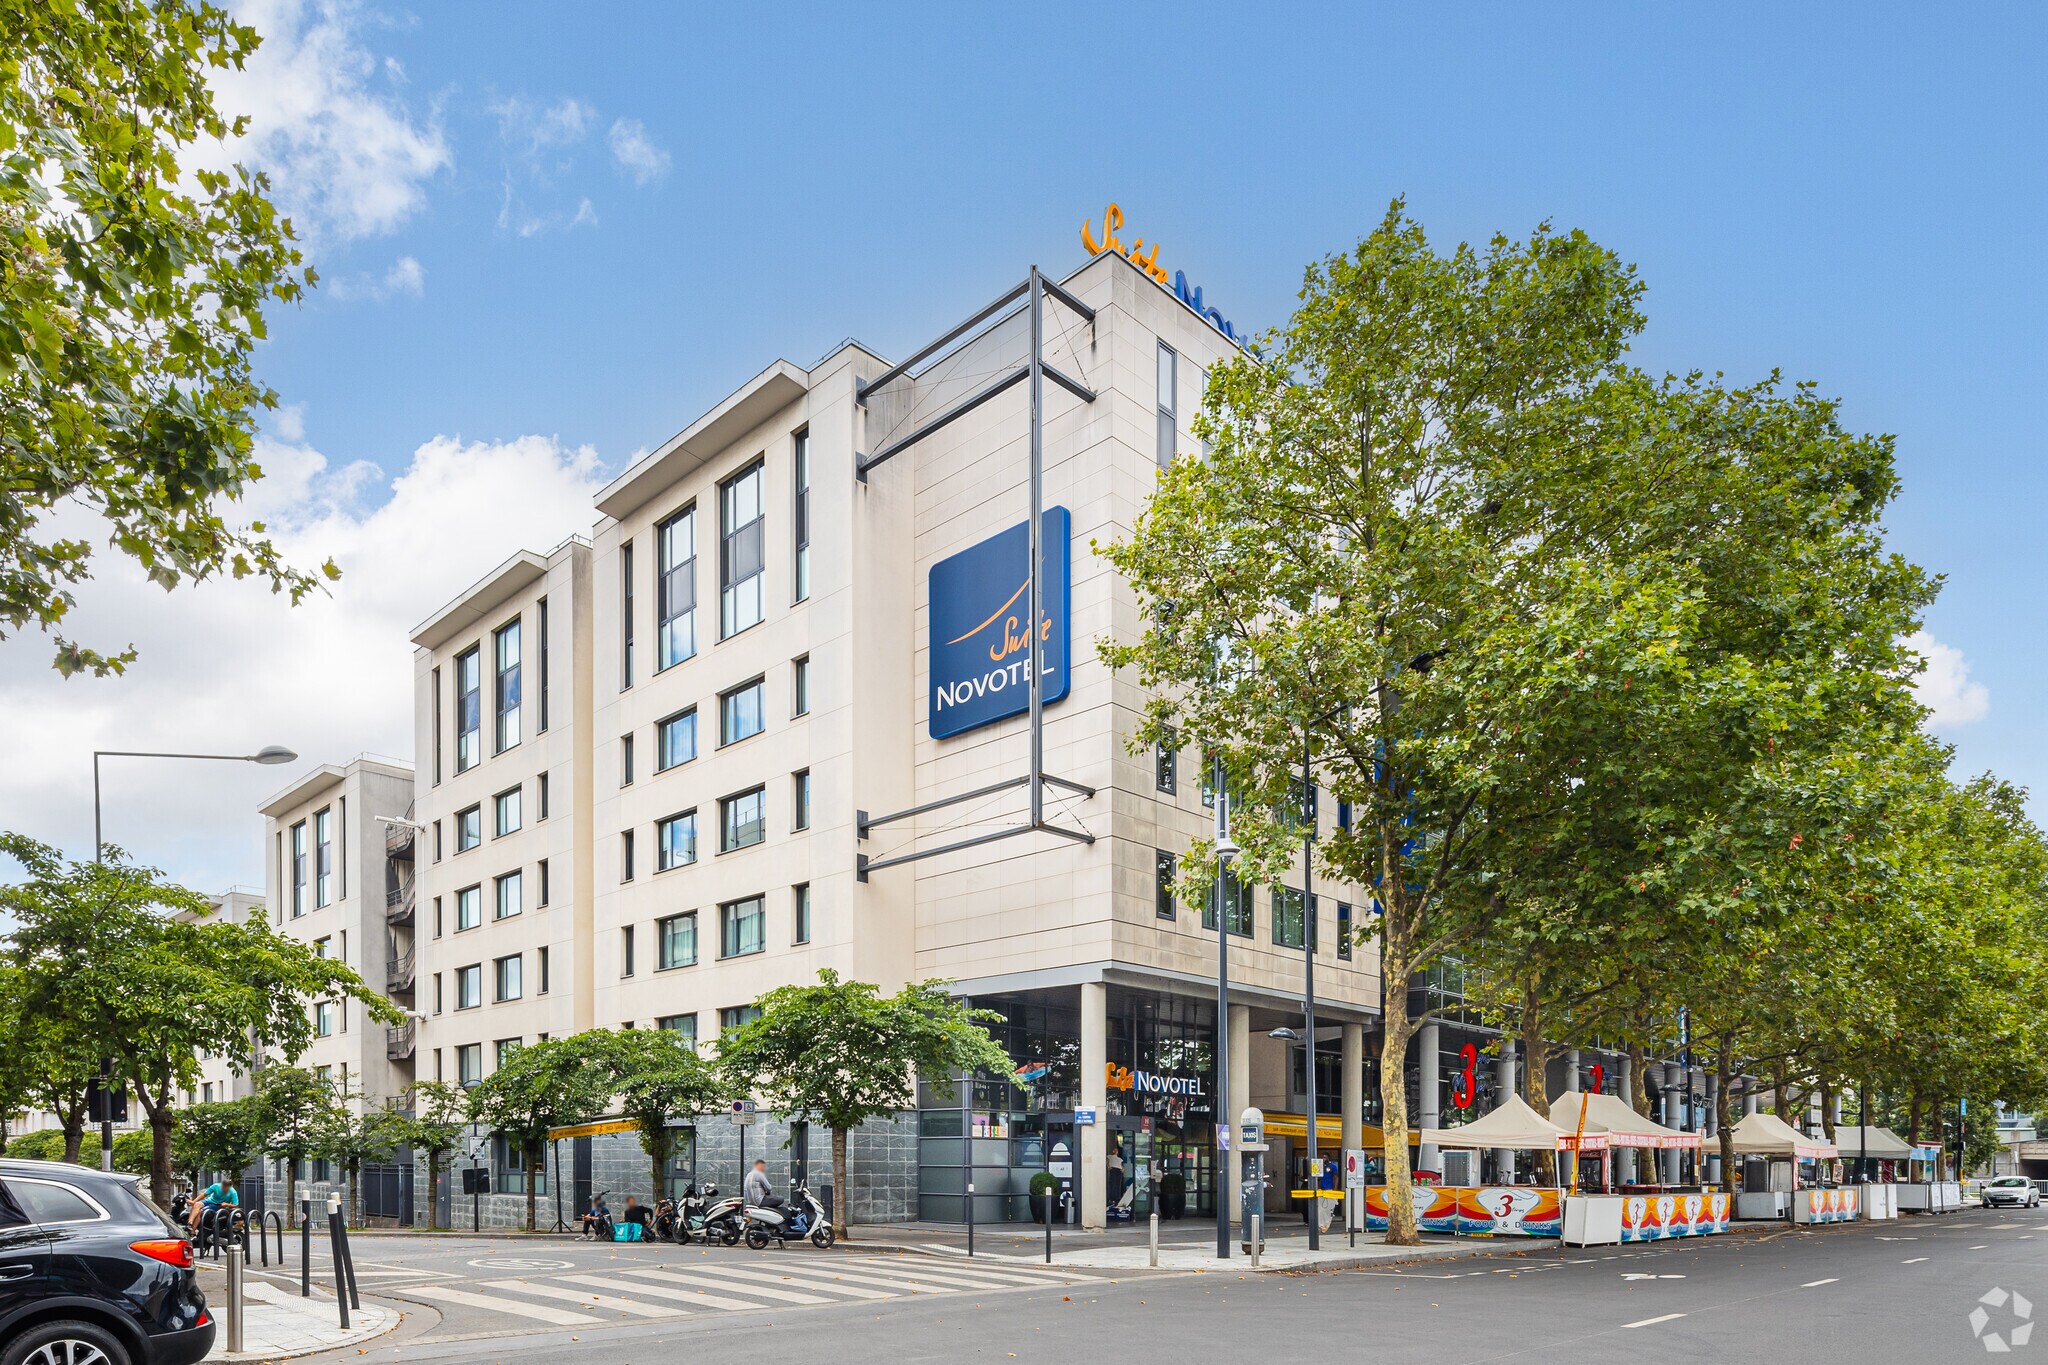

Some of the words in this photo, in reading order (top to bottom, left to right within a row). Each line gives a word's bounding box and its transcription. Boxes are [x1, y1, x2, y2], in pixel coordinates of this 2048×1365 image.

[990, 609, 1052, 661] Suie
[1137, 1071, 1206, 1096] NOVOTEL
[1243, 1131, 1257, 1140] TAXIS
[1494, 1194, 1514, 1218] 3
[1469, 1220, 1496, 1228] FOOD
[1515, 1221, 1552, 1230] DRINKS
